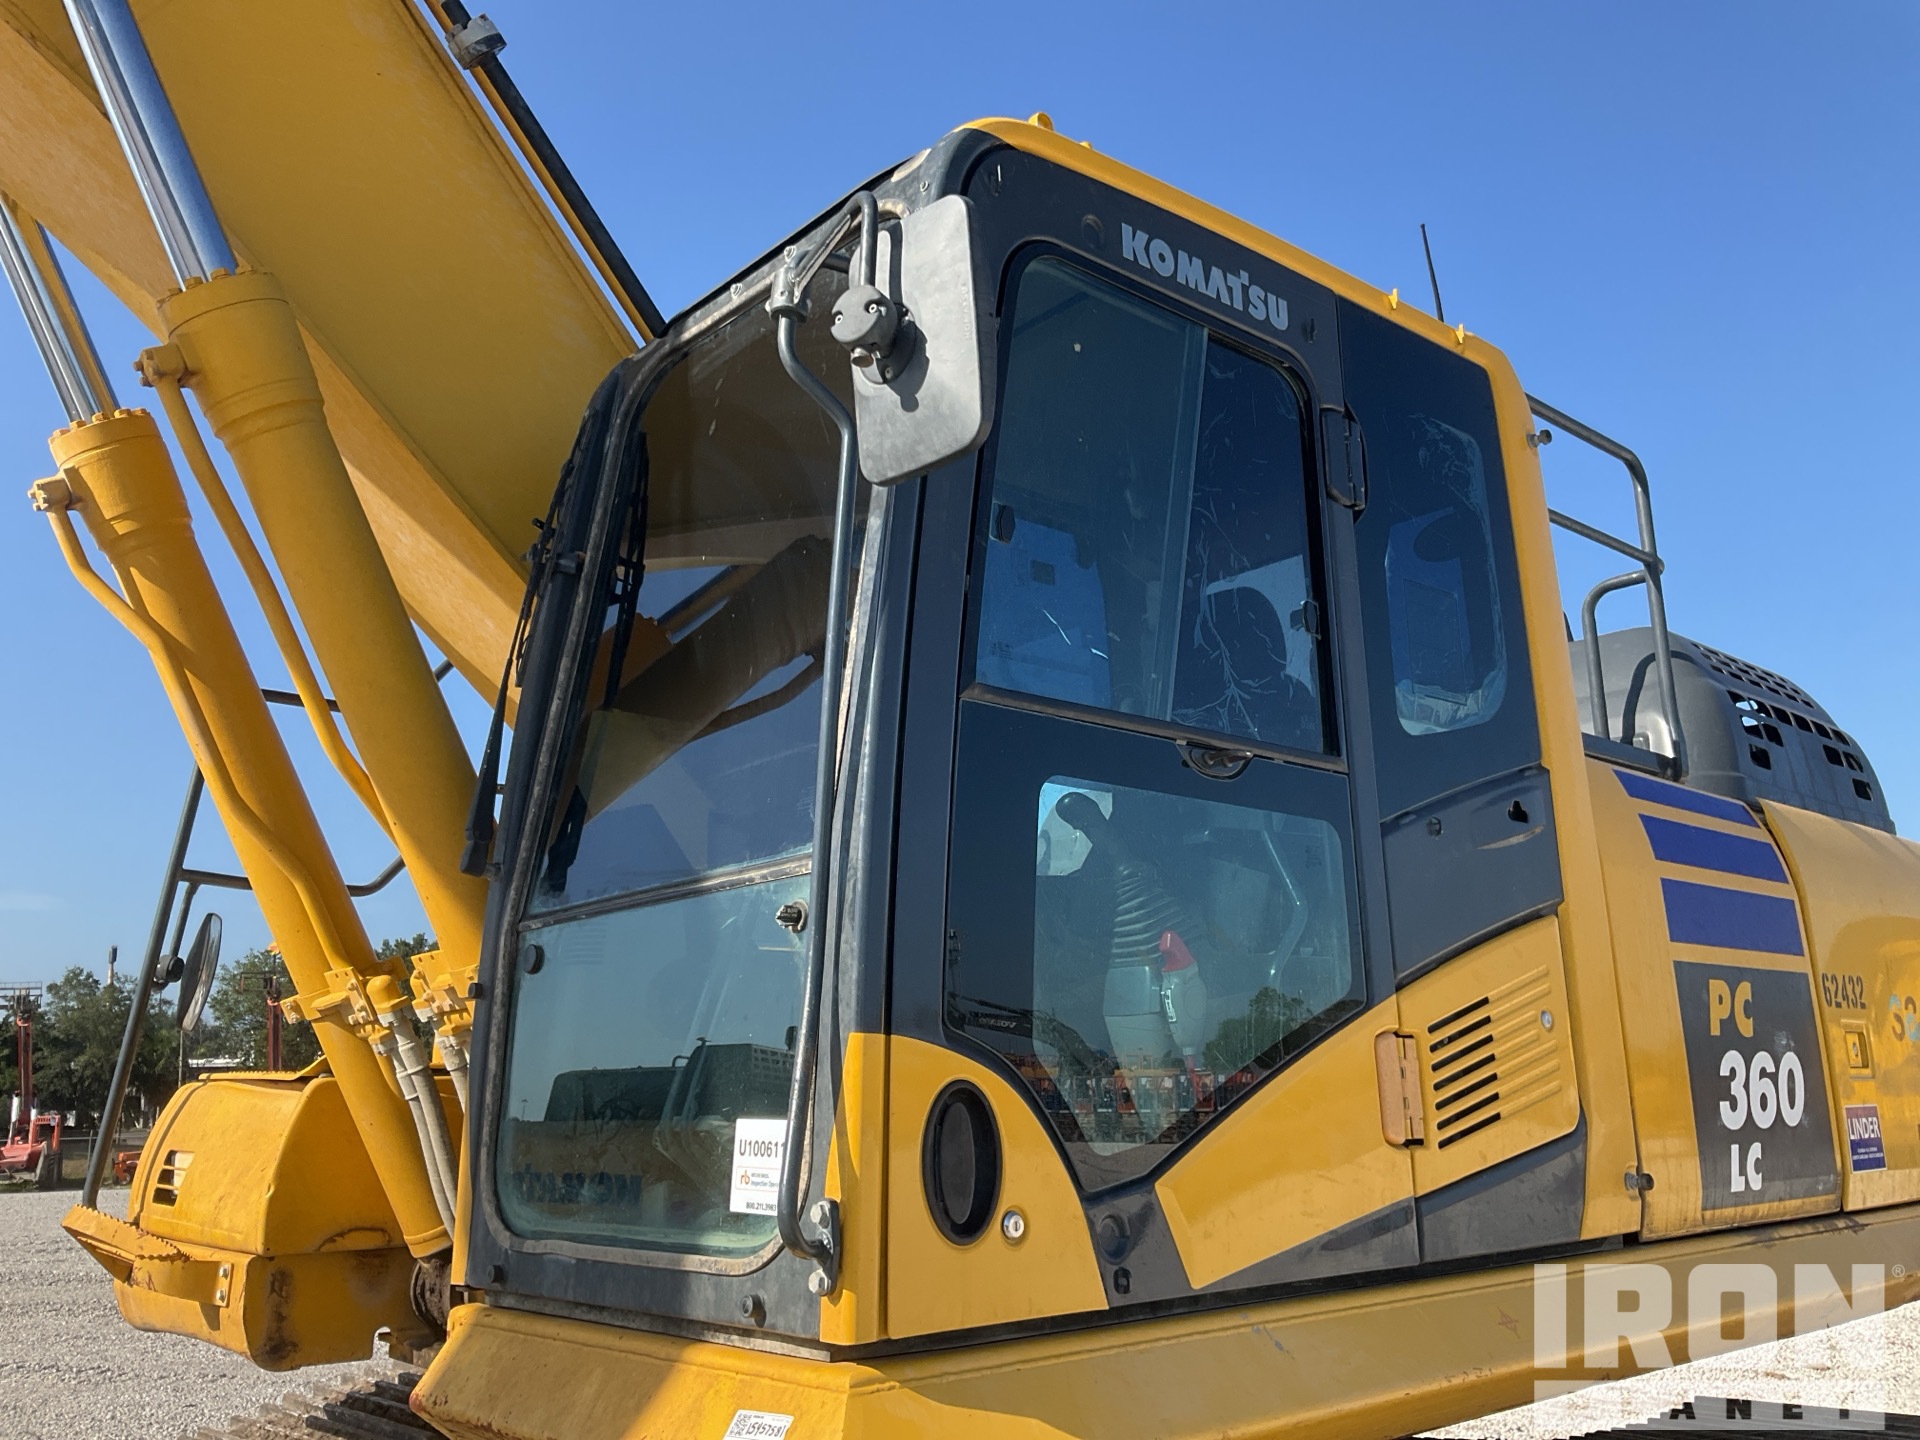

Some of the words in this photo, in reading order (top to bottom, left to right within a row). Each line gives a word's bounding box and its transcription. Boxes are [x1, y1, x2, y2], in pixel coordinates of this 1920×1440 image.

[1121, 222, 1289, 331] KOMATSU
[1708, 978, 1754, 1038] PC
[1821, 972, 1867, 1010] 62432
[1719, 1049, 1805, 1131] 360
[1847, 1116, 1881, 1140] LINDER
[1730, 1142, 1763, 1193] LC
